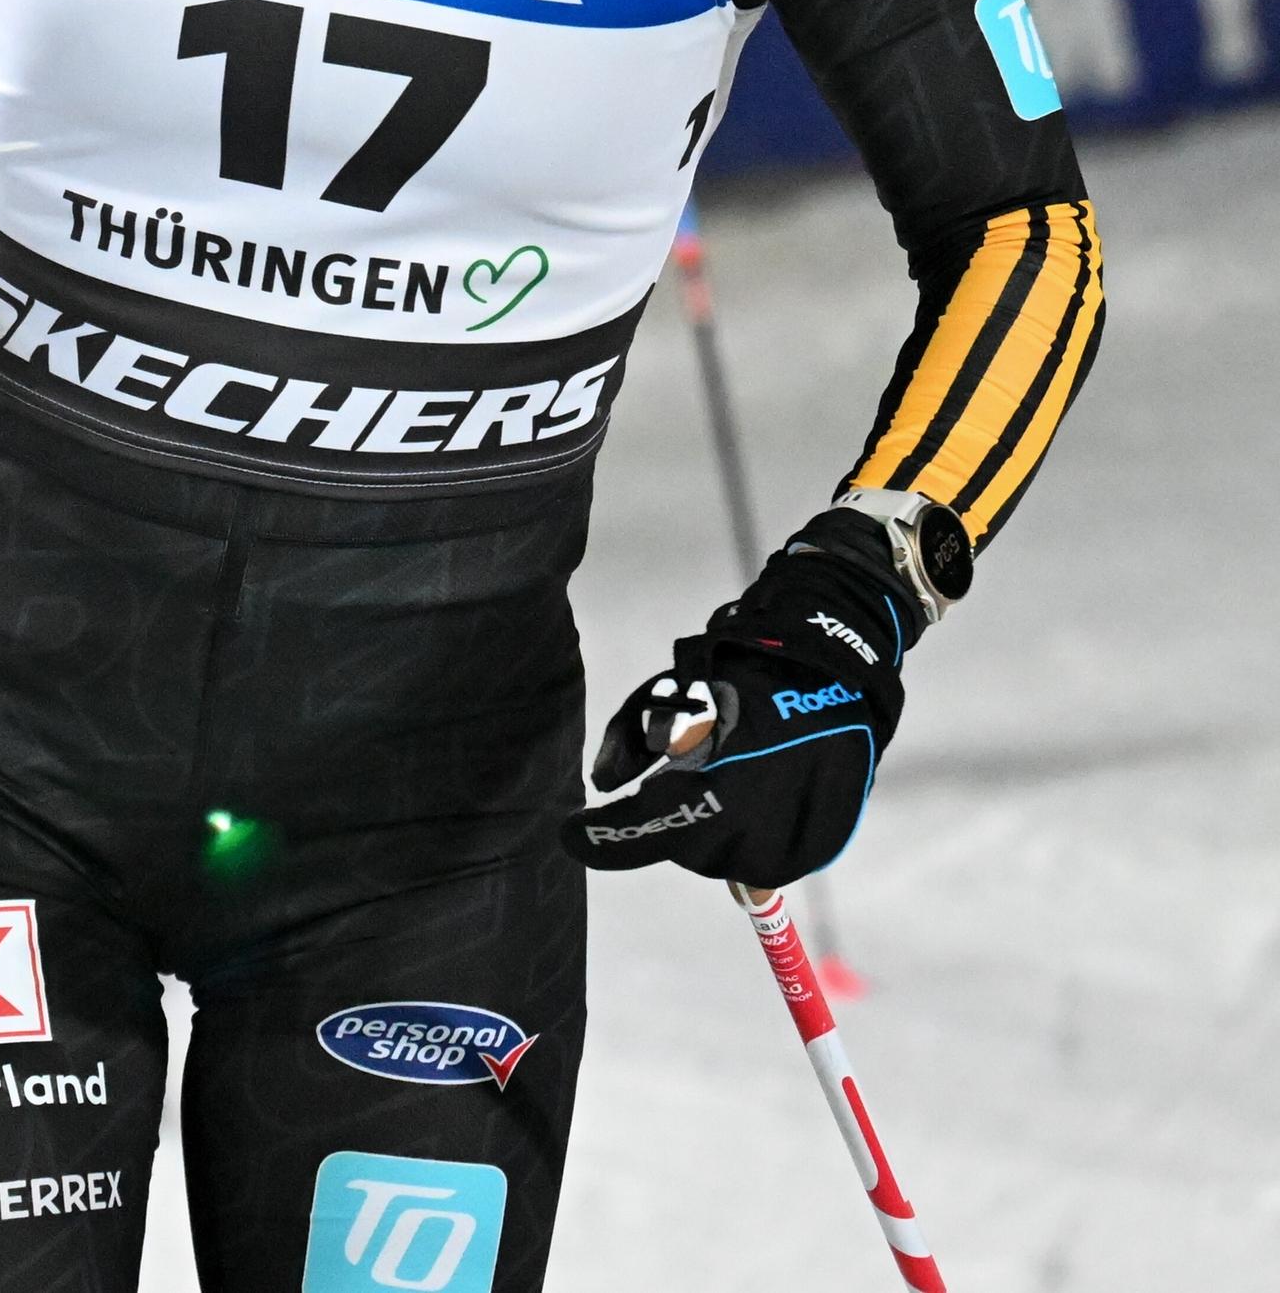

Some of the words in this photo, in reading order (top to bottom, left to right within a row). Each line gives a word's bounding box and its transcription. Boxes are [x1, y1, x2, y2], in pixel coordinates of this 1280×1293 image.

[61, 188, 450, 315] THÜRINGEN
[805, 611, 880, 666] swix
[585, 790, 724, 845] Roeckl
[335, 1016, 509, 1049] personal
[366, 1035, 466, 1071] shop
